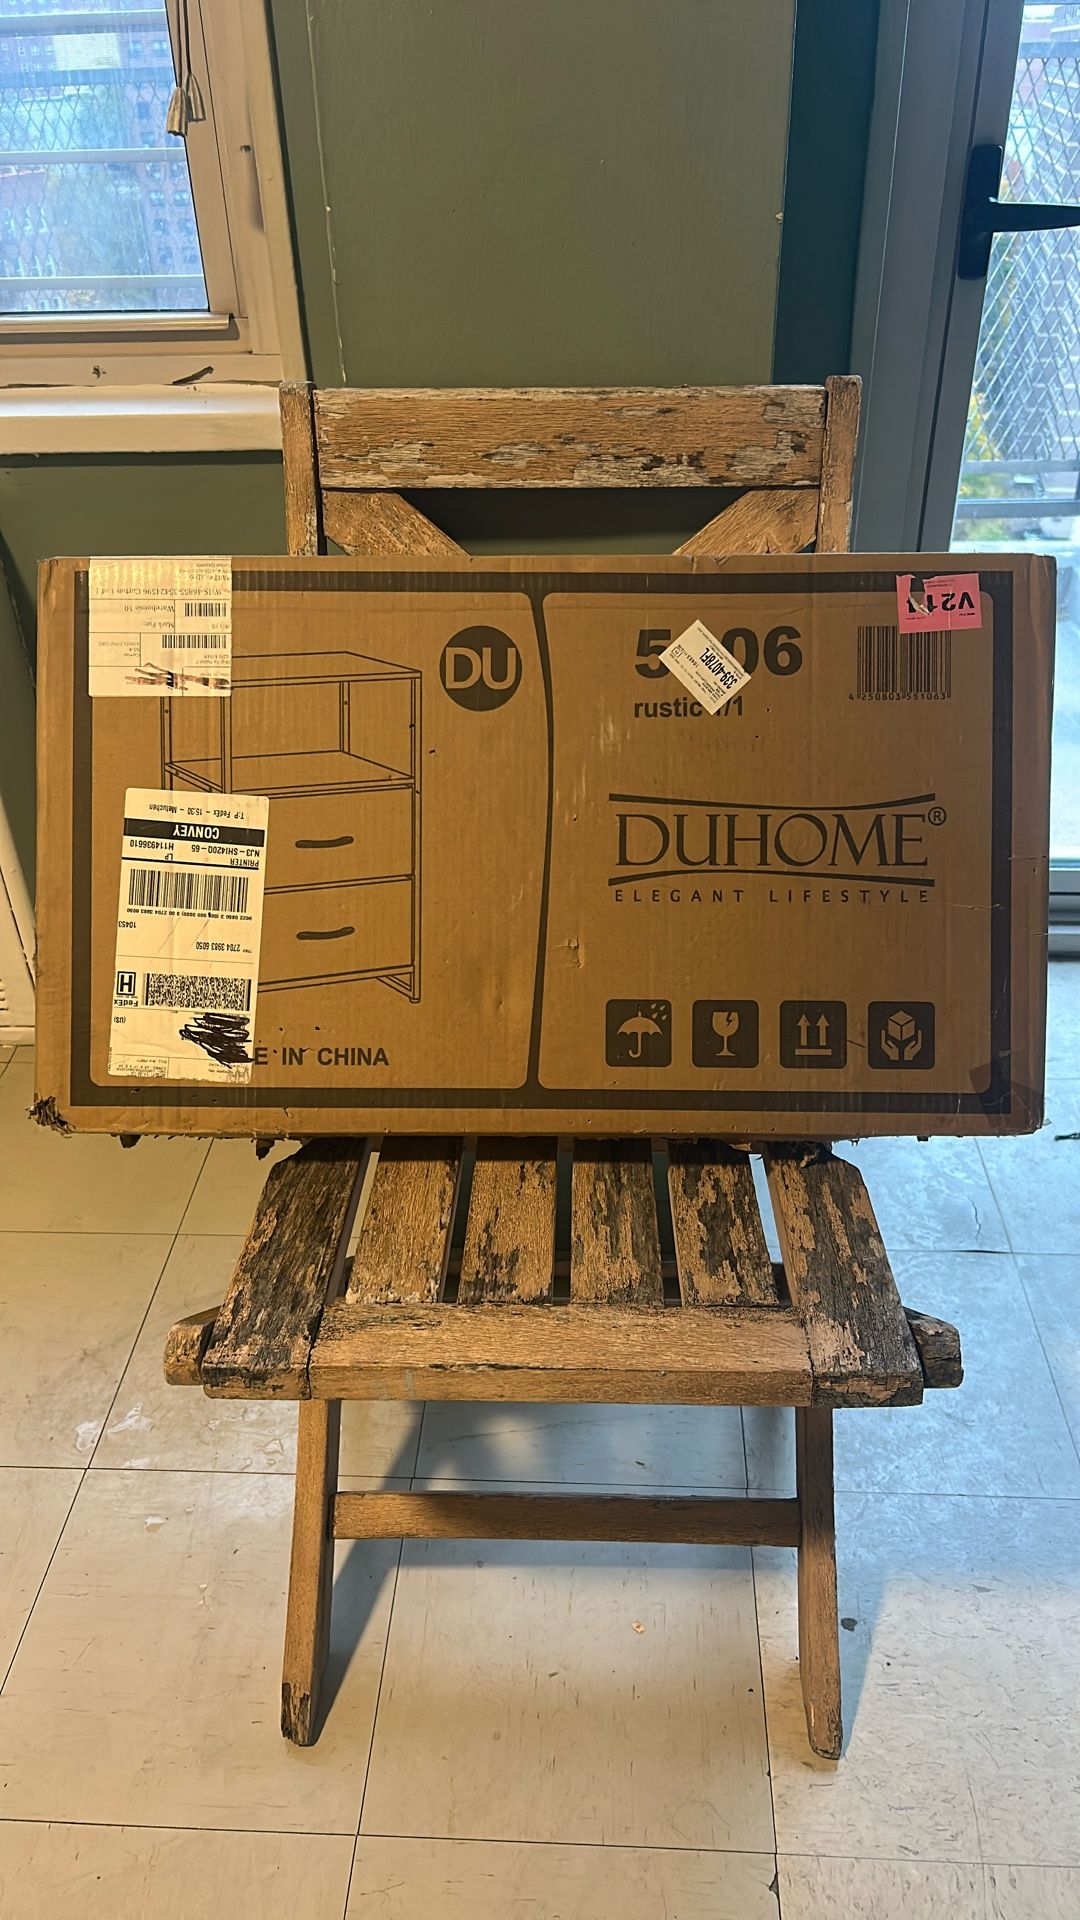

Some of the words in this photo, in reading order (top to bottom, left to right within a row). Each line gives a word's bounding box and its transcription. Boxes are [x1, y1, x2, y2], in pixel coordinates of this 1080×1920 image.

[135, 605, 175, 613] Warehouse
[634, 625, 803, 679] 506
[445, 645, 516, 690] DU
[700, 647, 737, 689] 339-4078FL
[848, 693, 854, 701] 4
[862, 692, 900, 701] 250803
[906, 692, 946, 701] 551063
[634, 696, 702, 718] rustic
[149, 803, 177, 814] Metuchen
[187, 807, 203, 816] 15:30
[213, 810, 231, 819] FedEx
[173, 824, 220, 840] CONVEY
[230, 858, 259, 867] PRINTER
[615, 889, 745, 903] ELEGANT
[769, 889, 929, 903] LIFESTYLE
[118, 920, 137, 929] 10453
[195, 941, 210, 950] 6050
[211, 942, 225, 951] 3983
[226, 943, 241, 952] 2704
[113, 999, 139, 1007] FedEx
[113, 1016, 126, 1024] (US)
[282, 1047, 303, 1066] IN
[317, 1047, 390, 1066] CHINA
